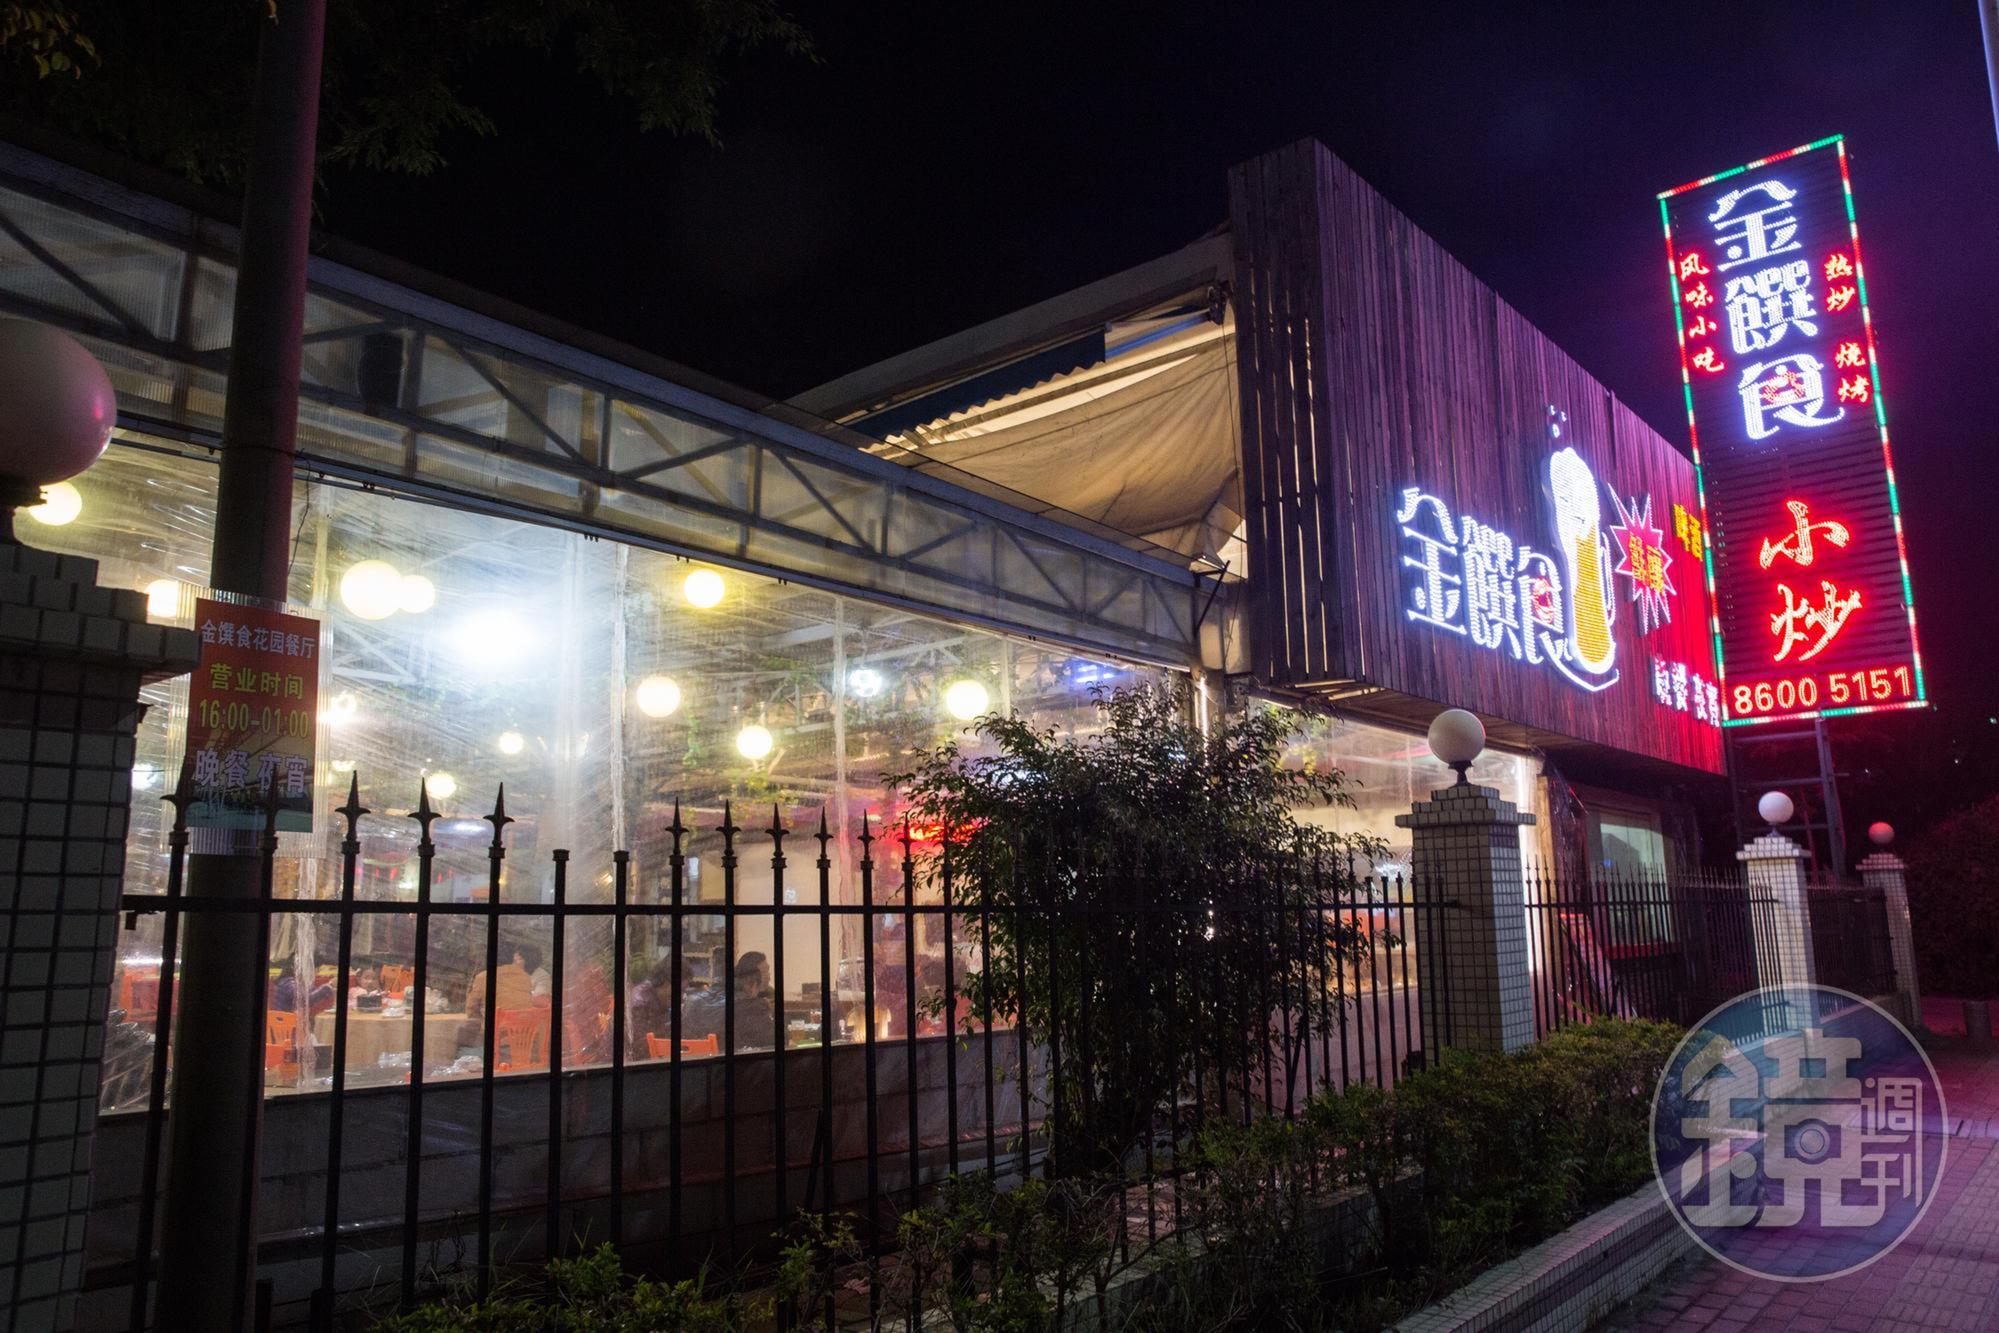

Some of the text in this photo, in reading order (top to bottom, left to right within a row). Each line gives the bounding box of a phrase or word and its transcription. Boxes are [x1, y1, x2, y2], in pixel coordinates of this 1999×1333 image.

[1679, 253, 1724, 373] 风味小吃
[1824, 254, 1871, 403] 热炒 烧烤
[1760, 500, 1863, 662] 小炒
[200, 618, 315, 659] 金馔食花园餐厅
[210, 662, 304, 700] 营业时间
[1733, 665, 1911, 714] 8600 5151
[199, 698, 309, 740] 16:00-01:00
[192, 749, 308, 794] 晚餐 夜宵
